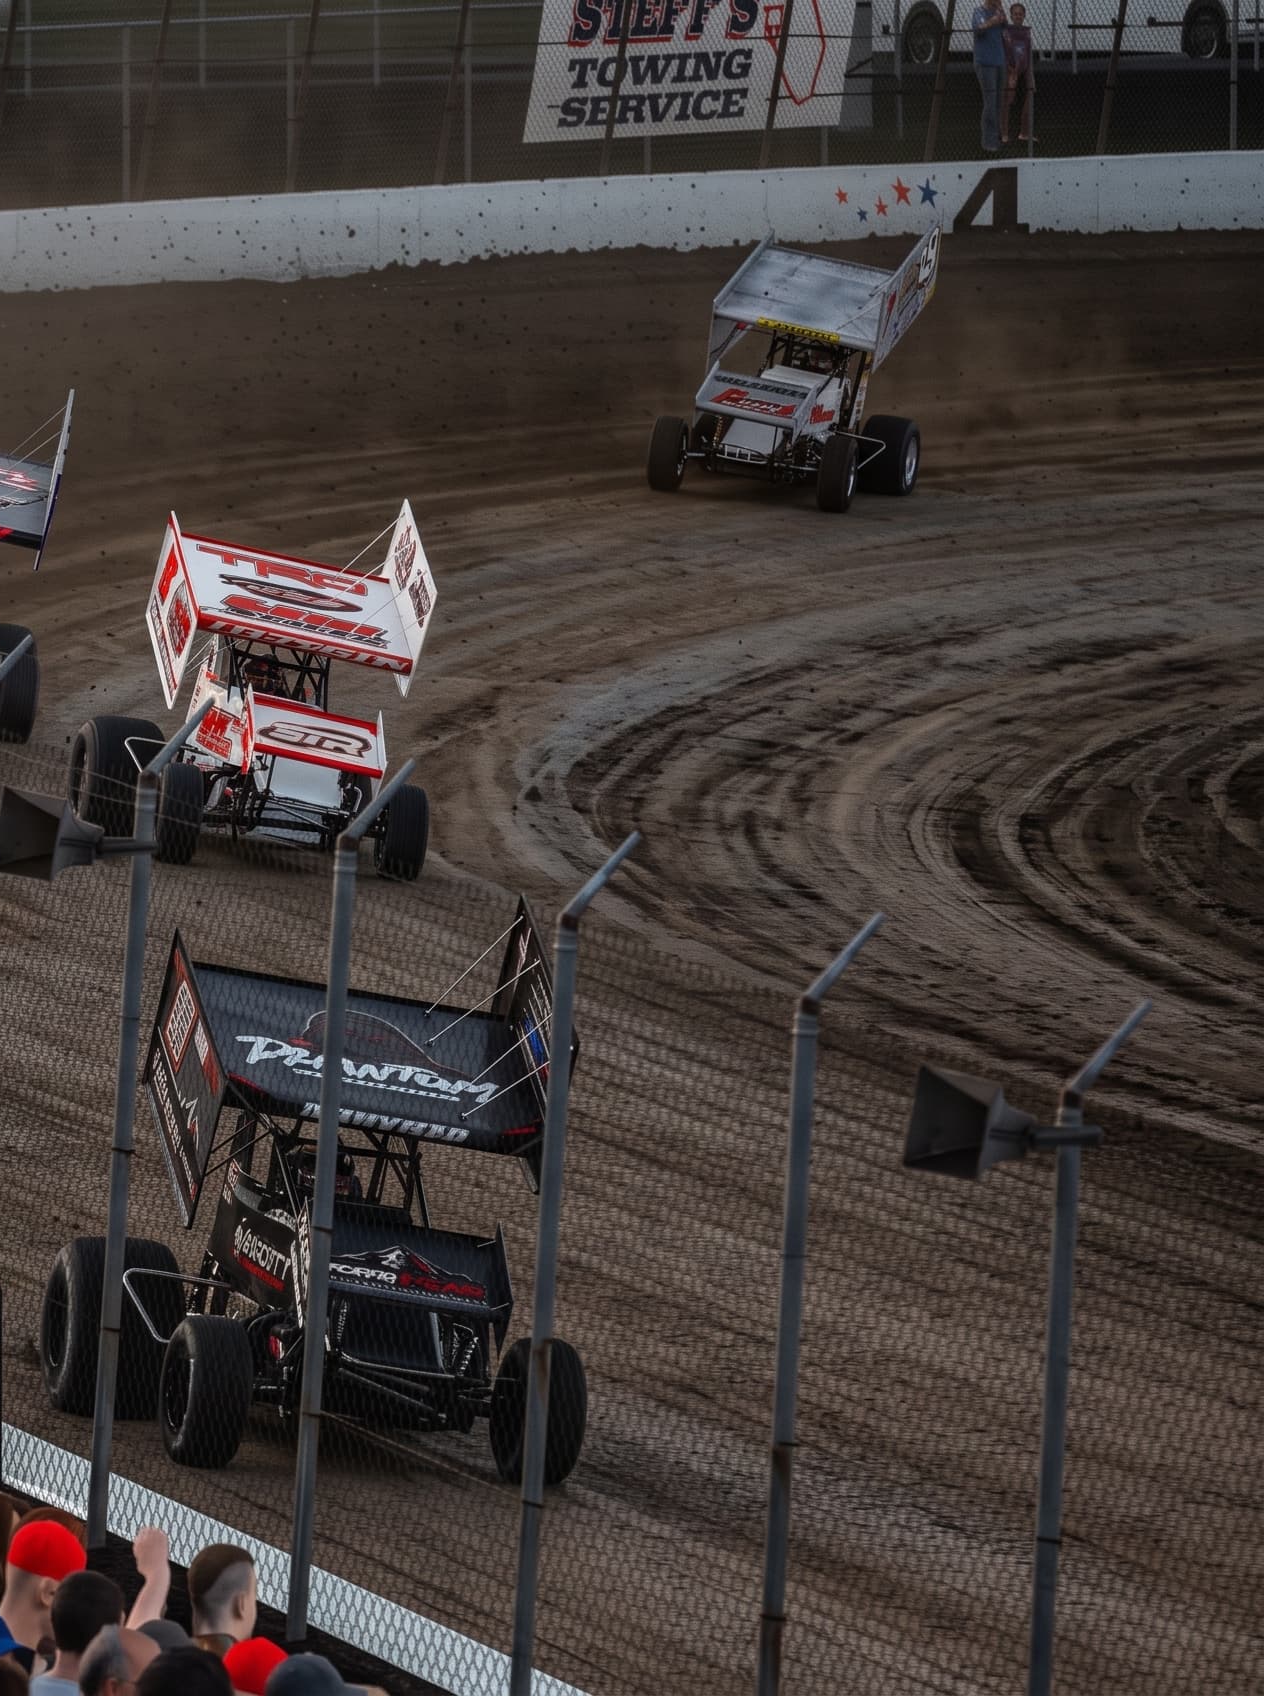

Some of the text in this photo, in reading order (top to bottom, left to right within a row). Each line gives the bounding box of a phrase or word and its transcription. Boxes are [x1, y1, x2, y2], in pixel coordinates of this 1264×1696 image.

[569, 0, 760, 46] STEFFS
[568, 49, 753, 89] TOWING
[558, 88, 748, 128] SERVICE
[953, 167, 1028, 232] 4
